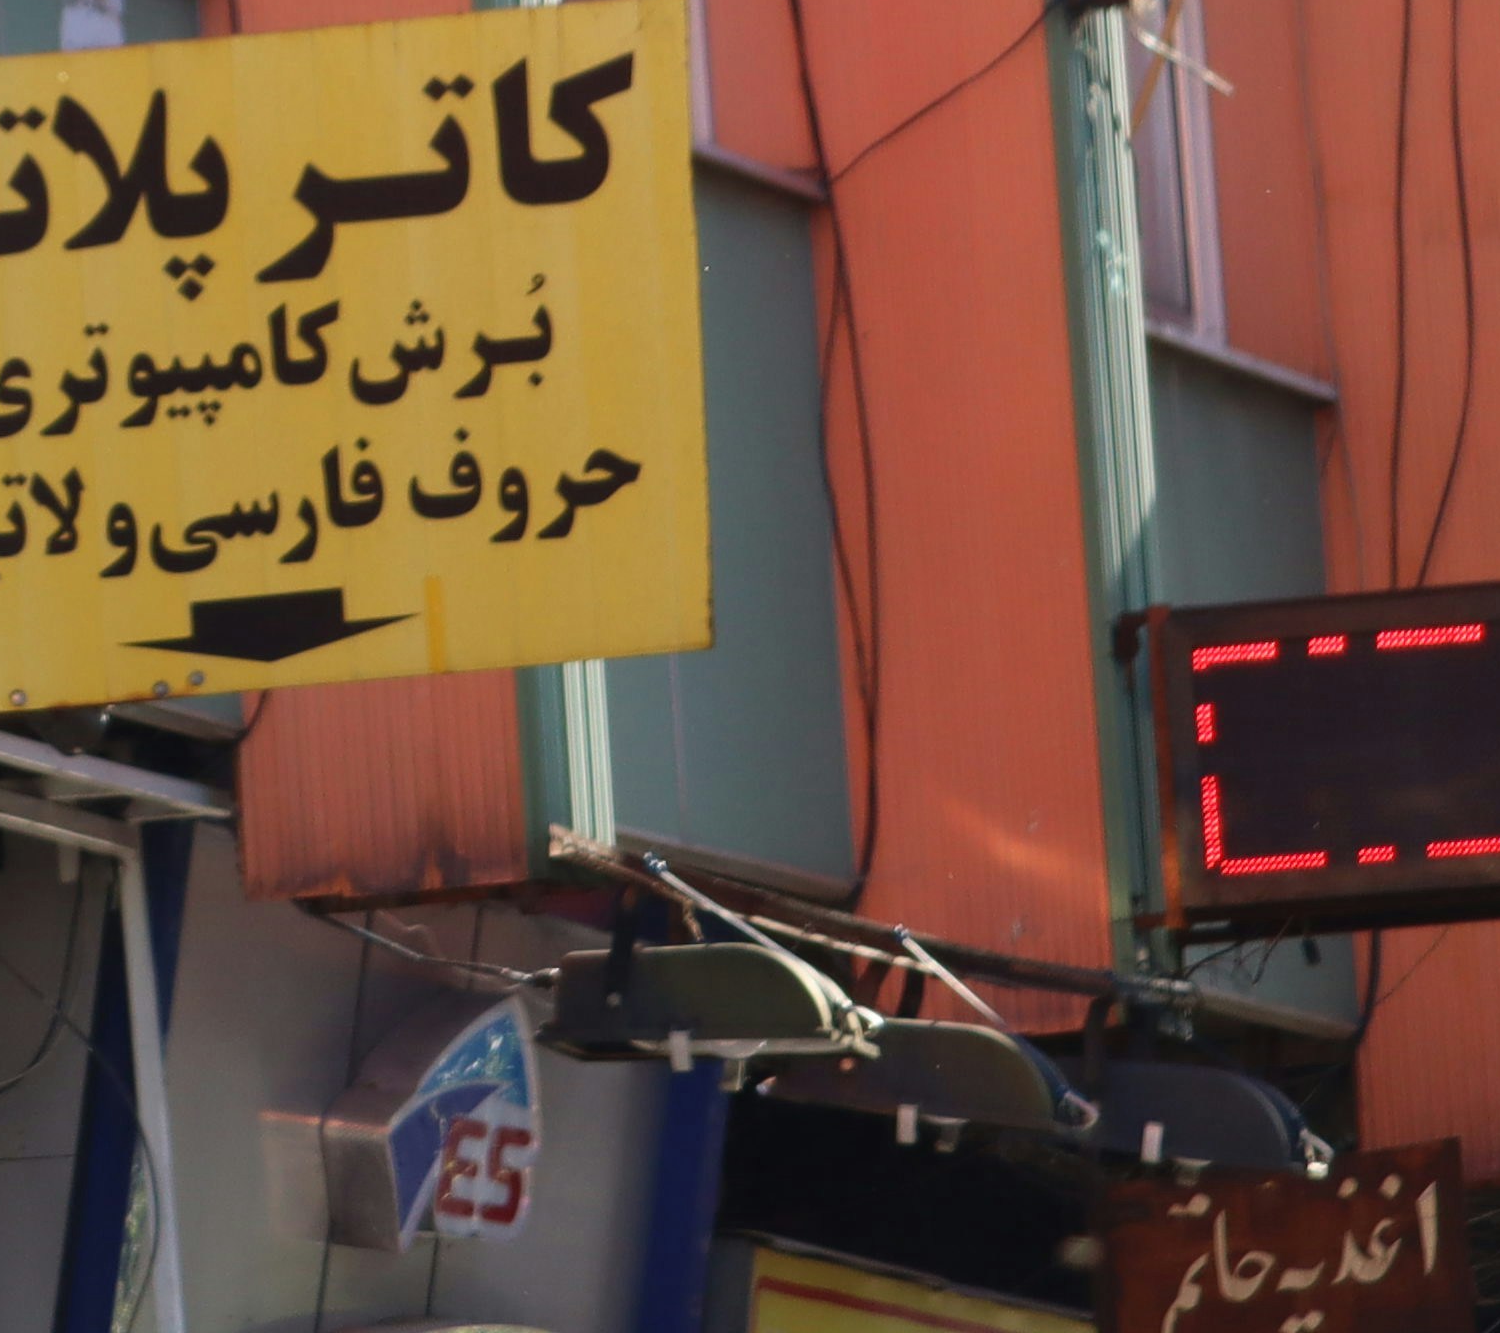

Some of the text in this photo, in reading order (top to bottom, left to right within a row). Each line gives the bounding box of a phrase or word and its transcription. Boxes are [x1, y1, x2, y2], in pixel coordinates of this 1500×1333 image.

[256, 51, 635, 284] کاتر
[98, 496, 139, 578] و
[149, 437, 385, 574] فارسی
[408, 427, 643, 543] حروف
[1275, 1171, 1440, 1333] اغذیه
